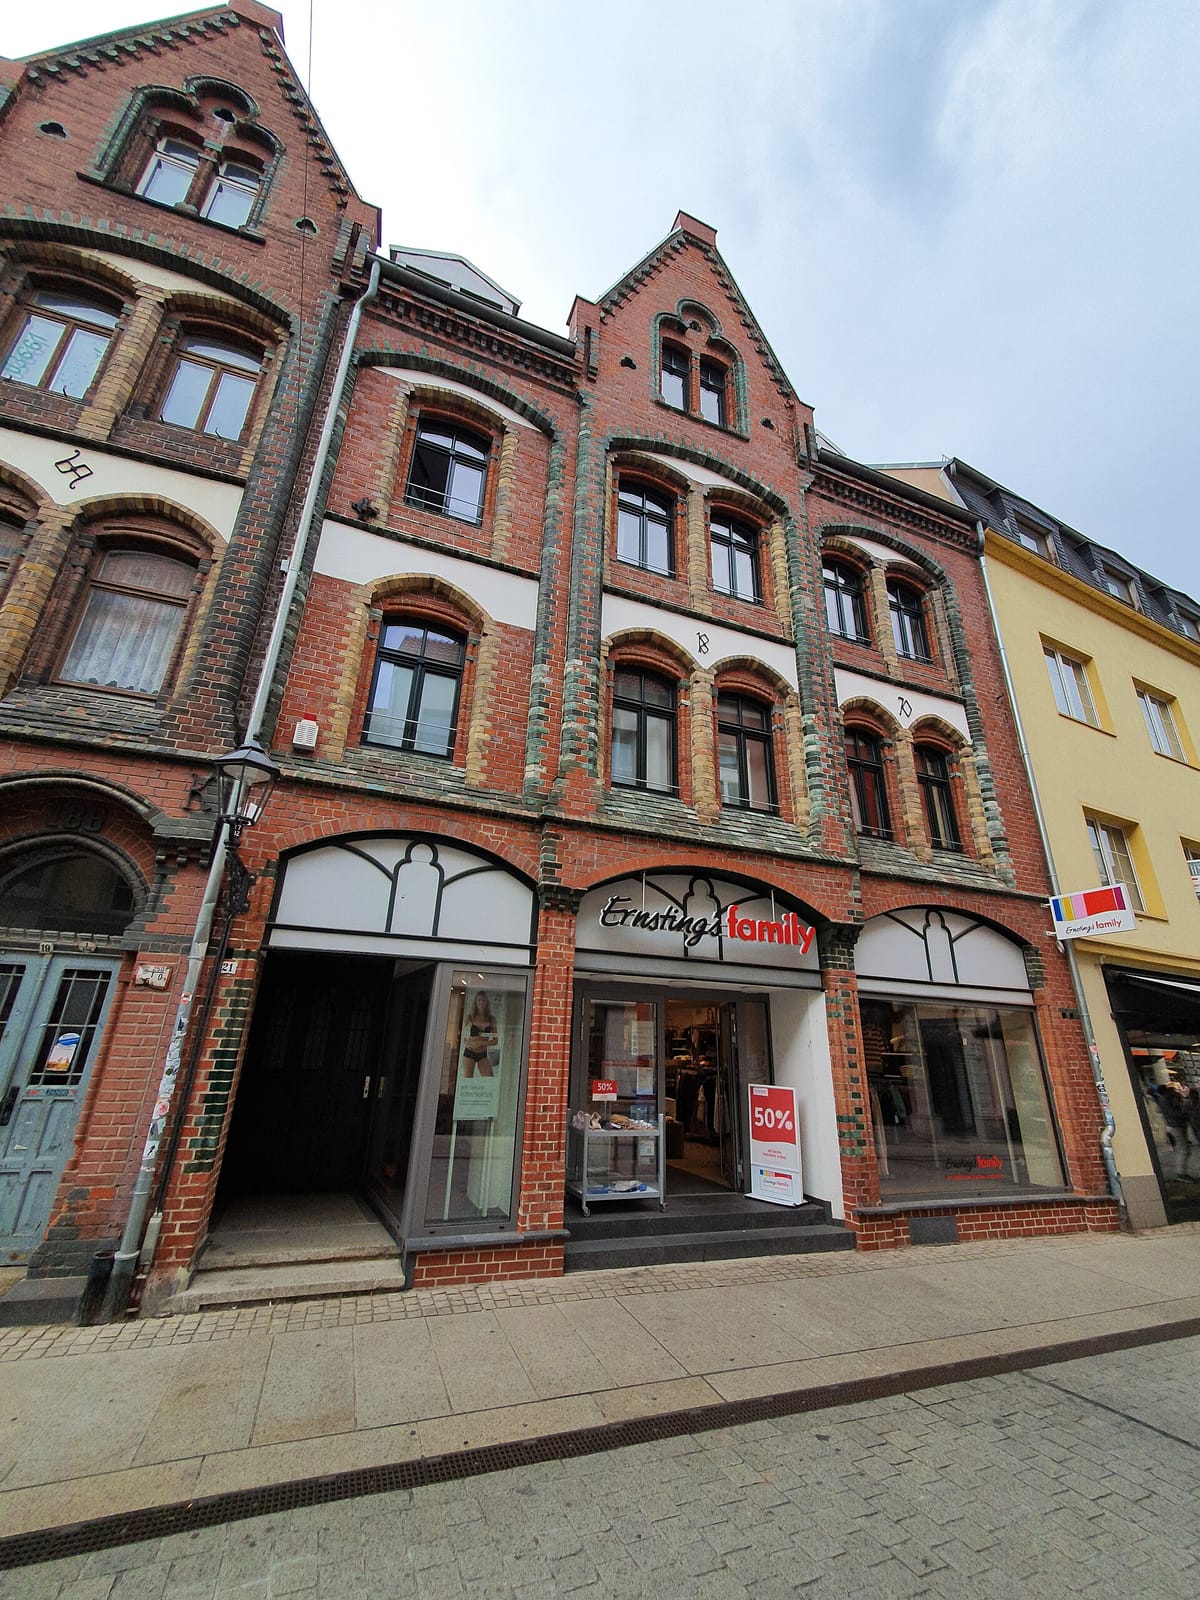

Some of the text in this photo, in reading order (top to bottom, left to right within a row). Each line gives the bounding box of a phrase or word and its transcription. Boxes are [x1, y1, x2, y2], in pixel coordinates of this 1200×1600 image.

[598, 895, 816, 954] Ernsting's family
[1065, 917, 1122, 935] Ernsting's family
[40, 943, 51, 953] 19
[222, 962, 233, 972] 21
[597, 1082, 613, 1092] 50%
[754, 1106, 794, 1132] 50%
[975, 1154, 1003, 1169] family
